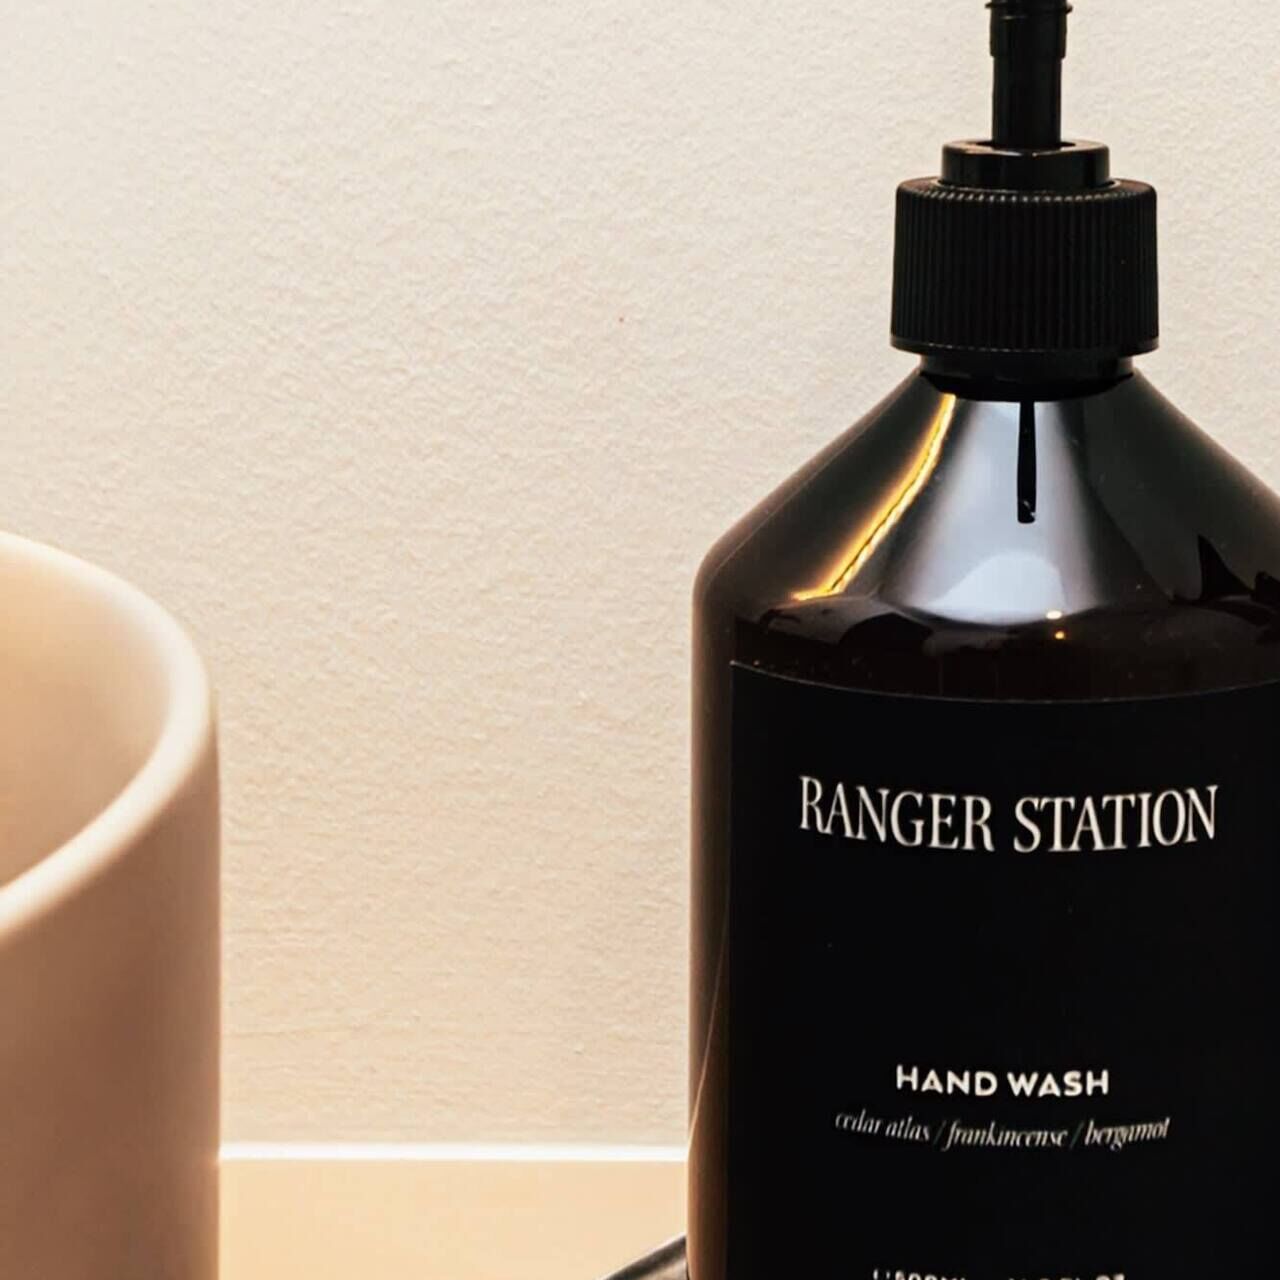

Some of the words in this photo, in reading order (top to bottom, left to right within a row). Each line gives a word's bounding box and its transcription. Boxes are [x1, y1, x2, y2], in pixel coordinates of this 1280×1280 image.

[799, 775, 995, 852] RANGER
[1013, 784, 1219, 853] STATION
[896, 1064, 998, 1097] HAND
[1006, 1069, 1109, 1098] WASH
[835, 1109, 881, 1134] cedar
[885, 1115, 930, 1141] atlas
[941, 1120, 1070, 1152] frankincense
[1084, 1117, 1171, 1151] bergamot
